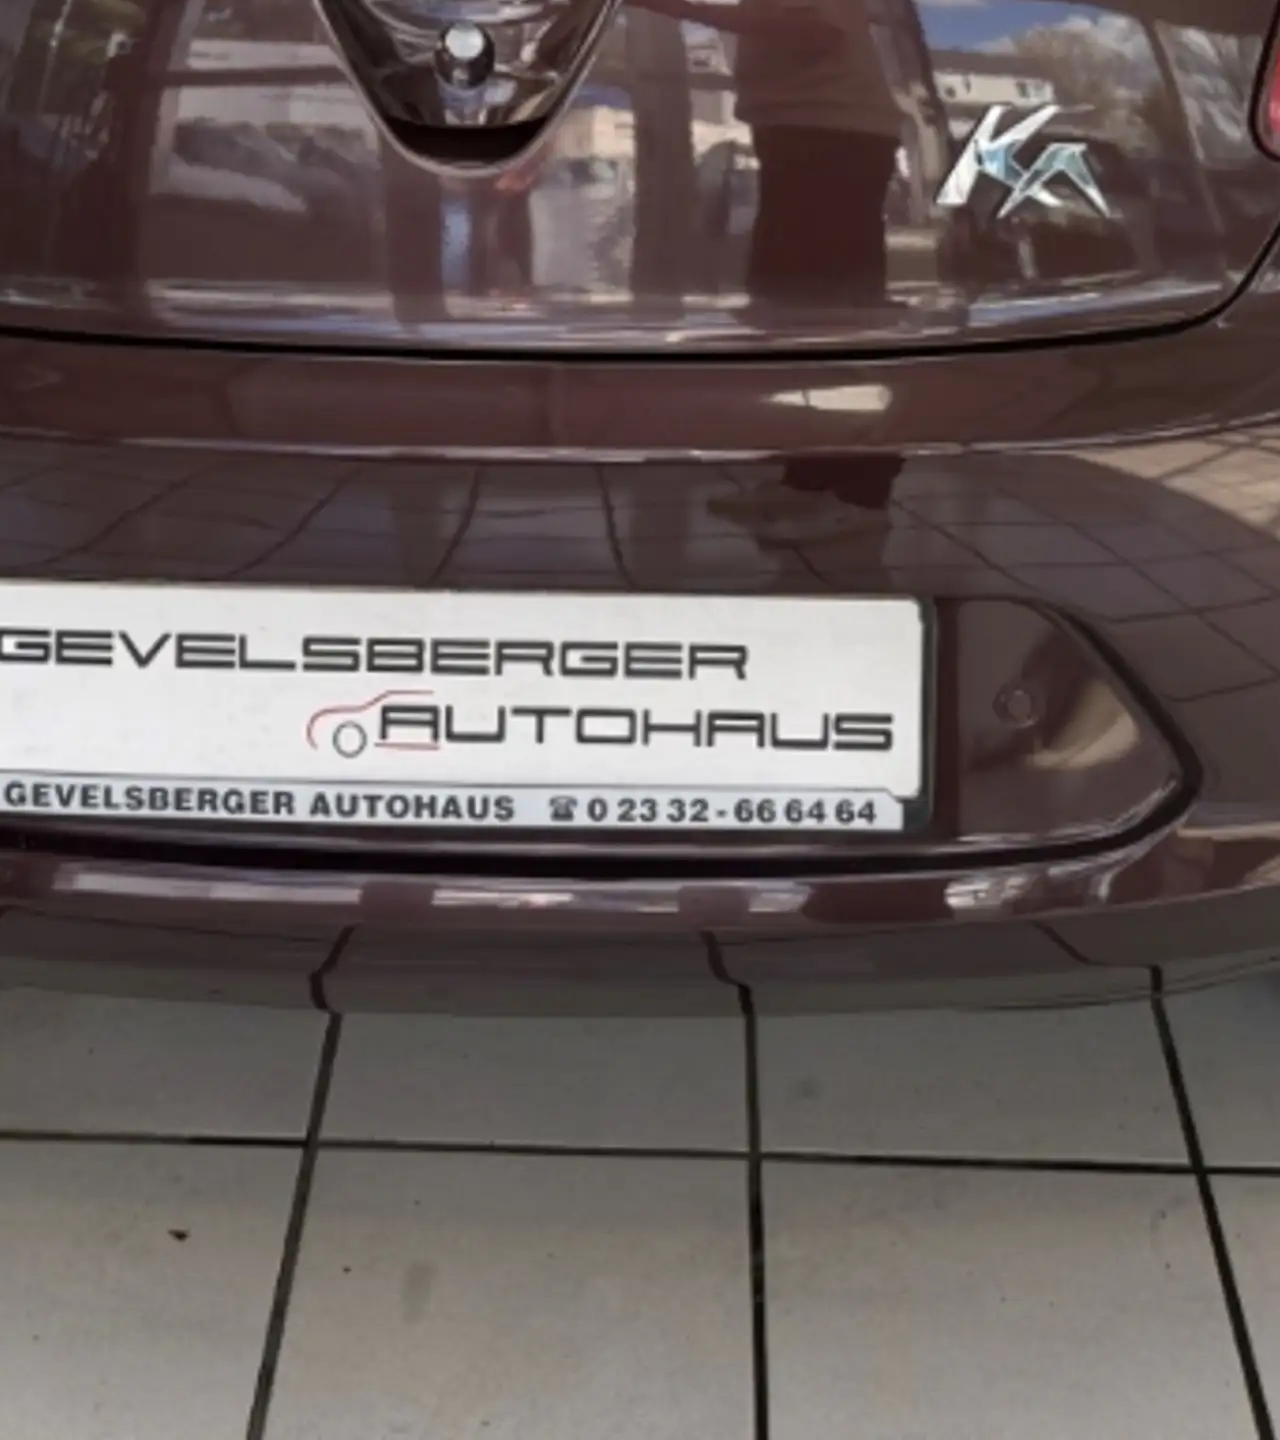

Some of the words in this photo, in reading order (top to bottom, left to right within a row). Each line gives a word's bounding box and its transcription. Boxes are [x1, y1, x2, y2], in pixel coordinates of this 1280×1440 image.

[379, 704, 894, 752] AUTOHAUS
[3, 781, 296, 816] GEVELSBERGER
[308, 792, 515, 822] AUTOHAUS
